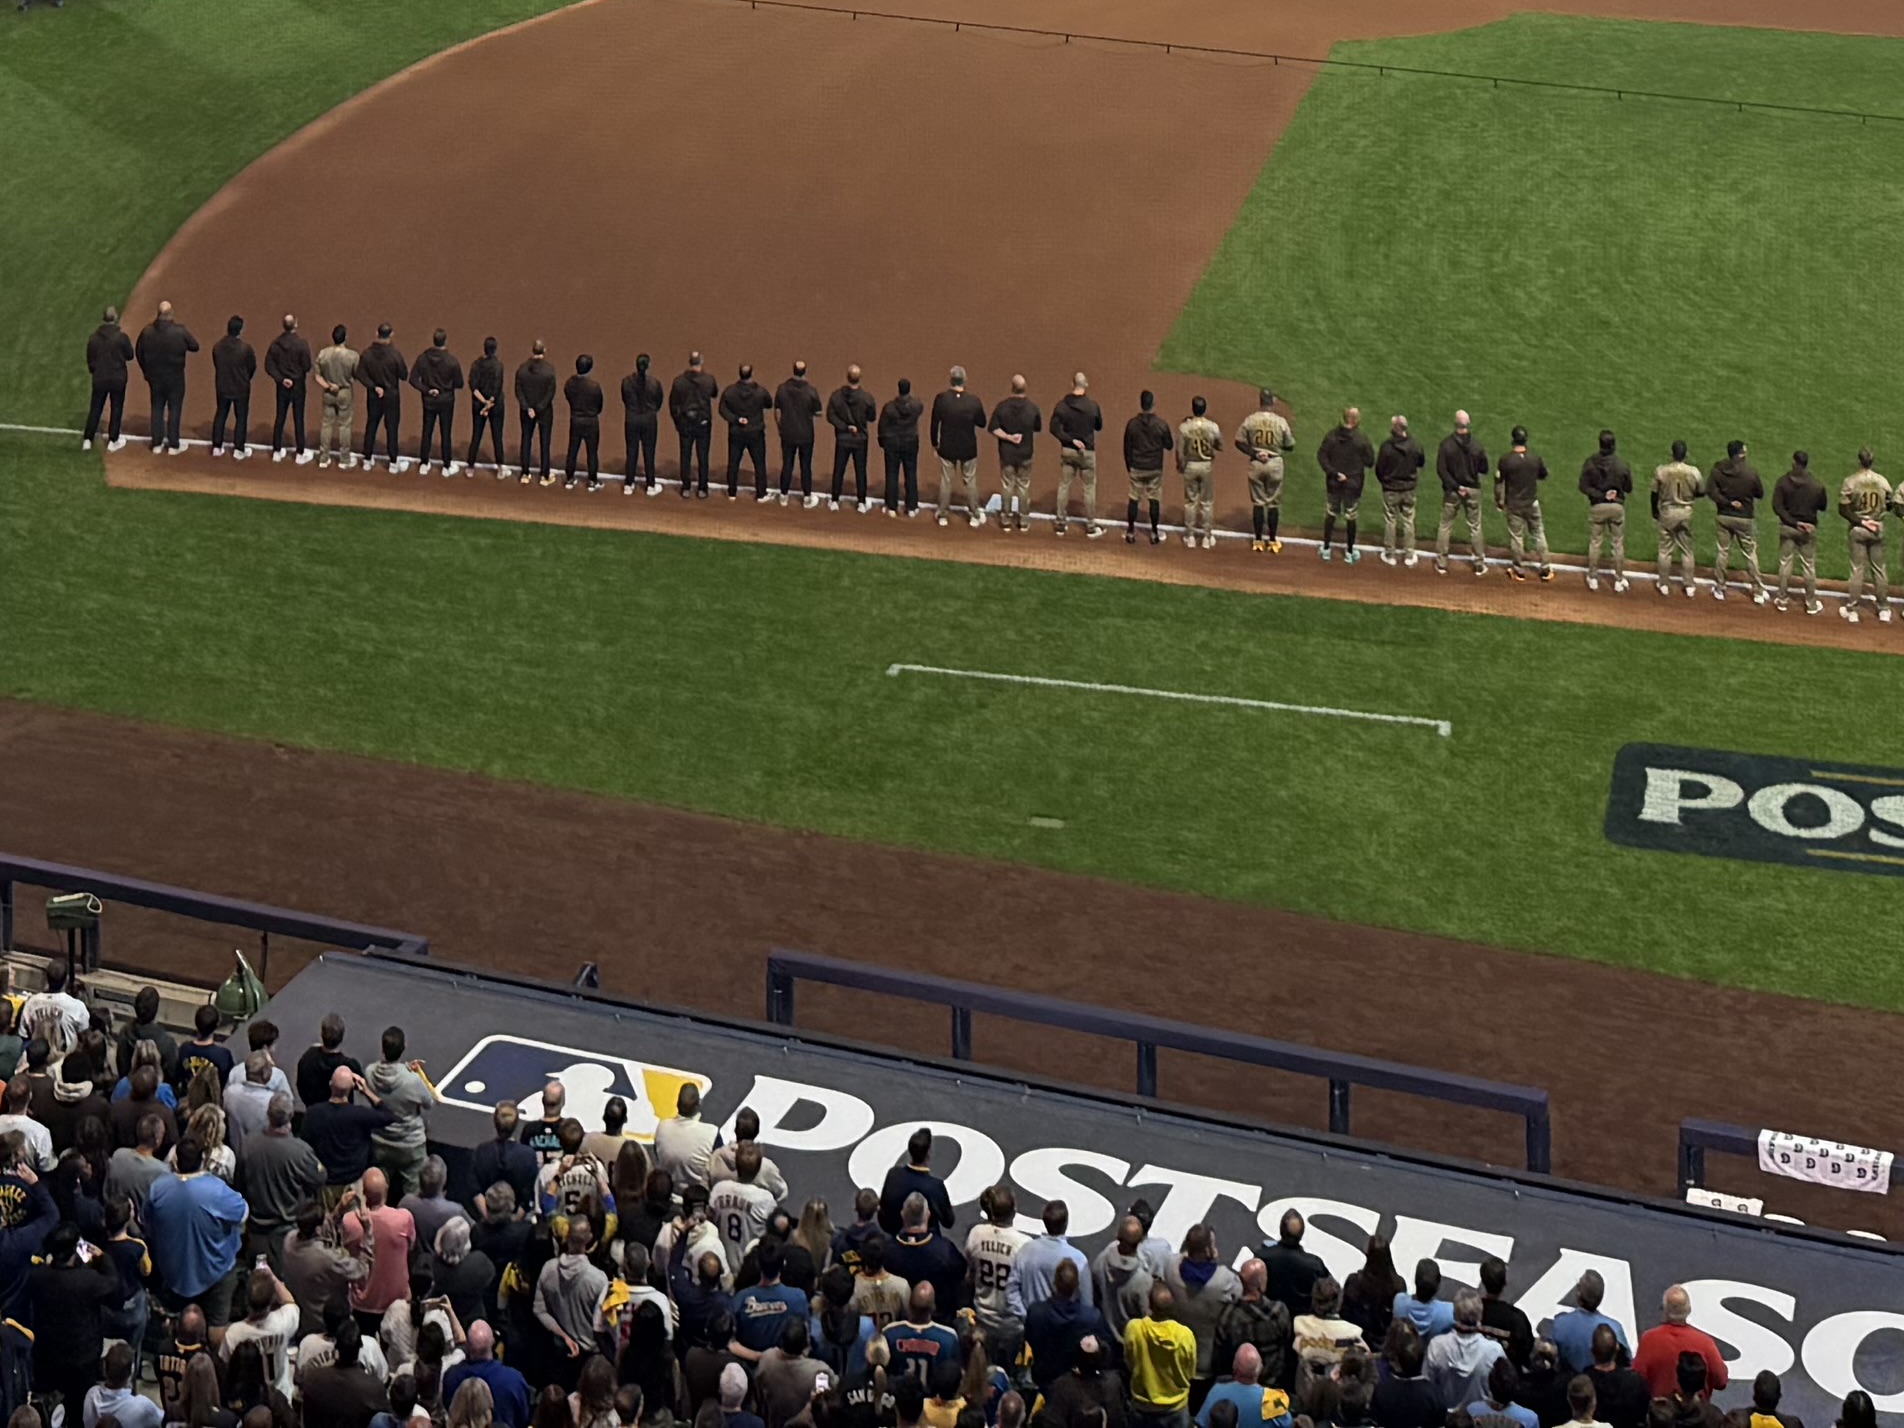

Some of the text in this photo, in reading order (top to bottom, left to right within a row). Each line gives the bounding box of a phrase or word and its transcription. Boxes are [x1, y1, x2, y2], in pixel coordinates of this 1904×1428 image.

[727, 1213, 742, 1242] 8
[980, 1239, 1013, 1257] YELICH
[980, 1260, 1013, 1292] 22
